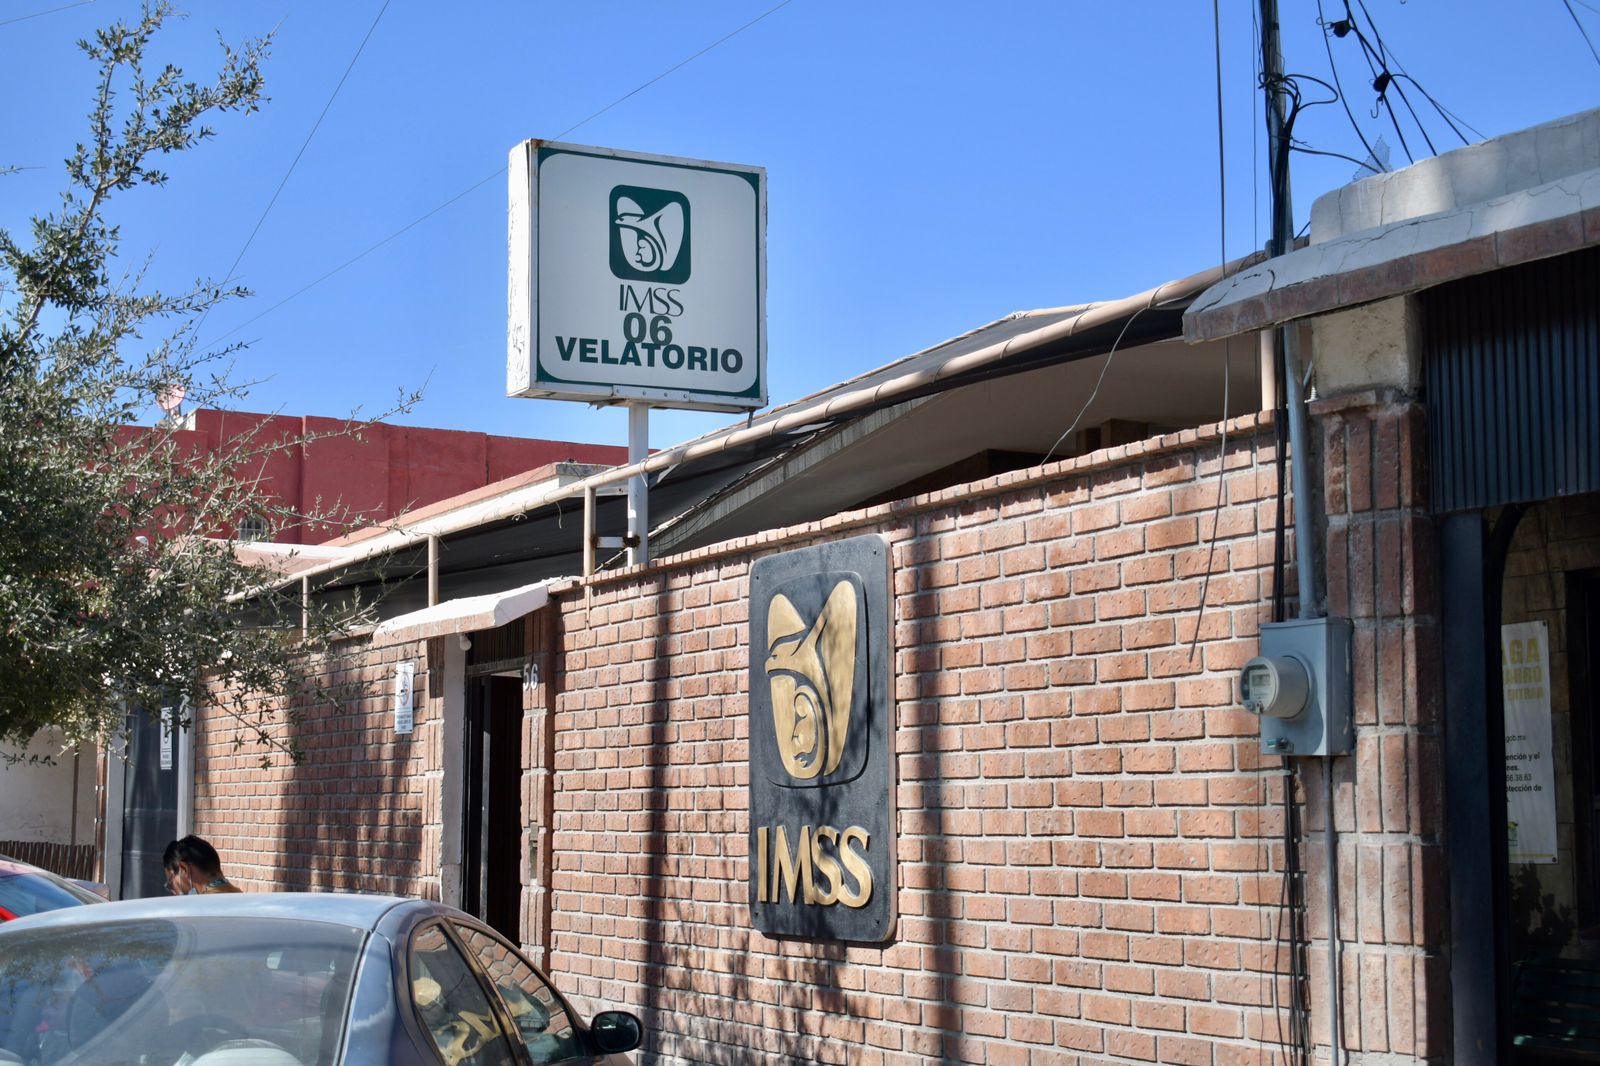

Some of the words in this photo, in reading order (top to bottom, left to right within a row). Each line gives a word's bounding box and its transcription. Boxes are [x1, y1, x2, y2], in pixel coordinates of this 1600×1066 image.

[619, 284, 684, 317] IMSS
[623, 312, 673, 346] 06
[555, 335, 744, 374] VELATORIO
[522, 663, 539, 691] 56
[1533, 784, 1542, 792] de
[756, 823, 873, 908] IMSS
